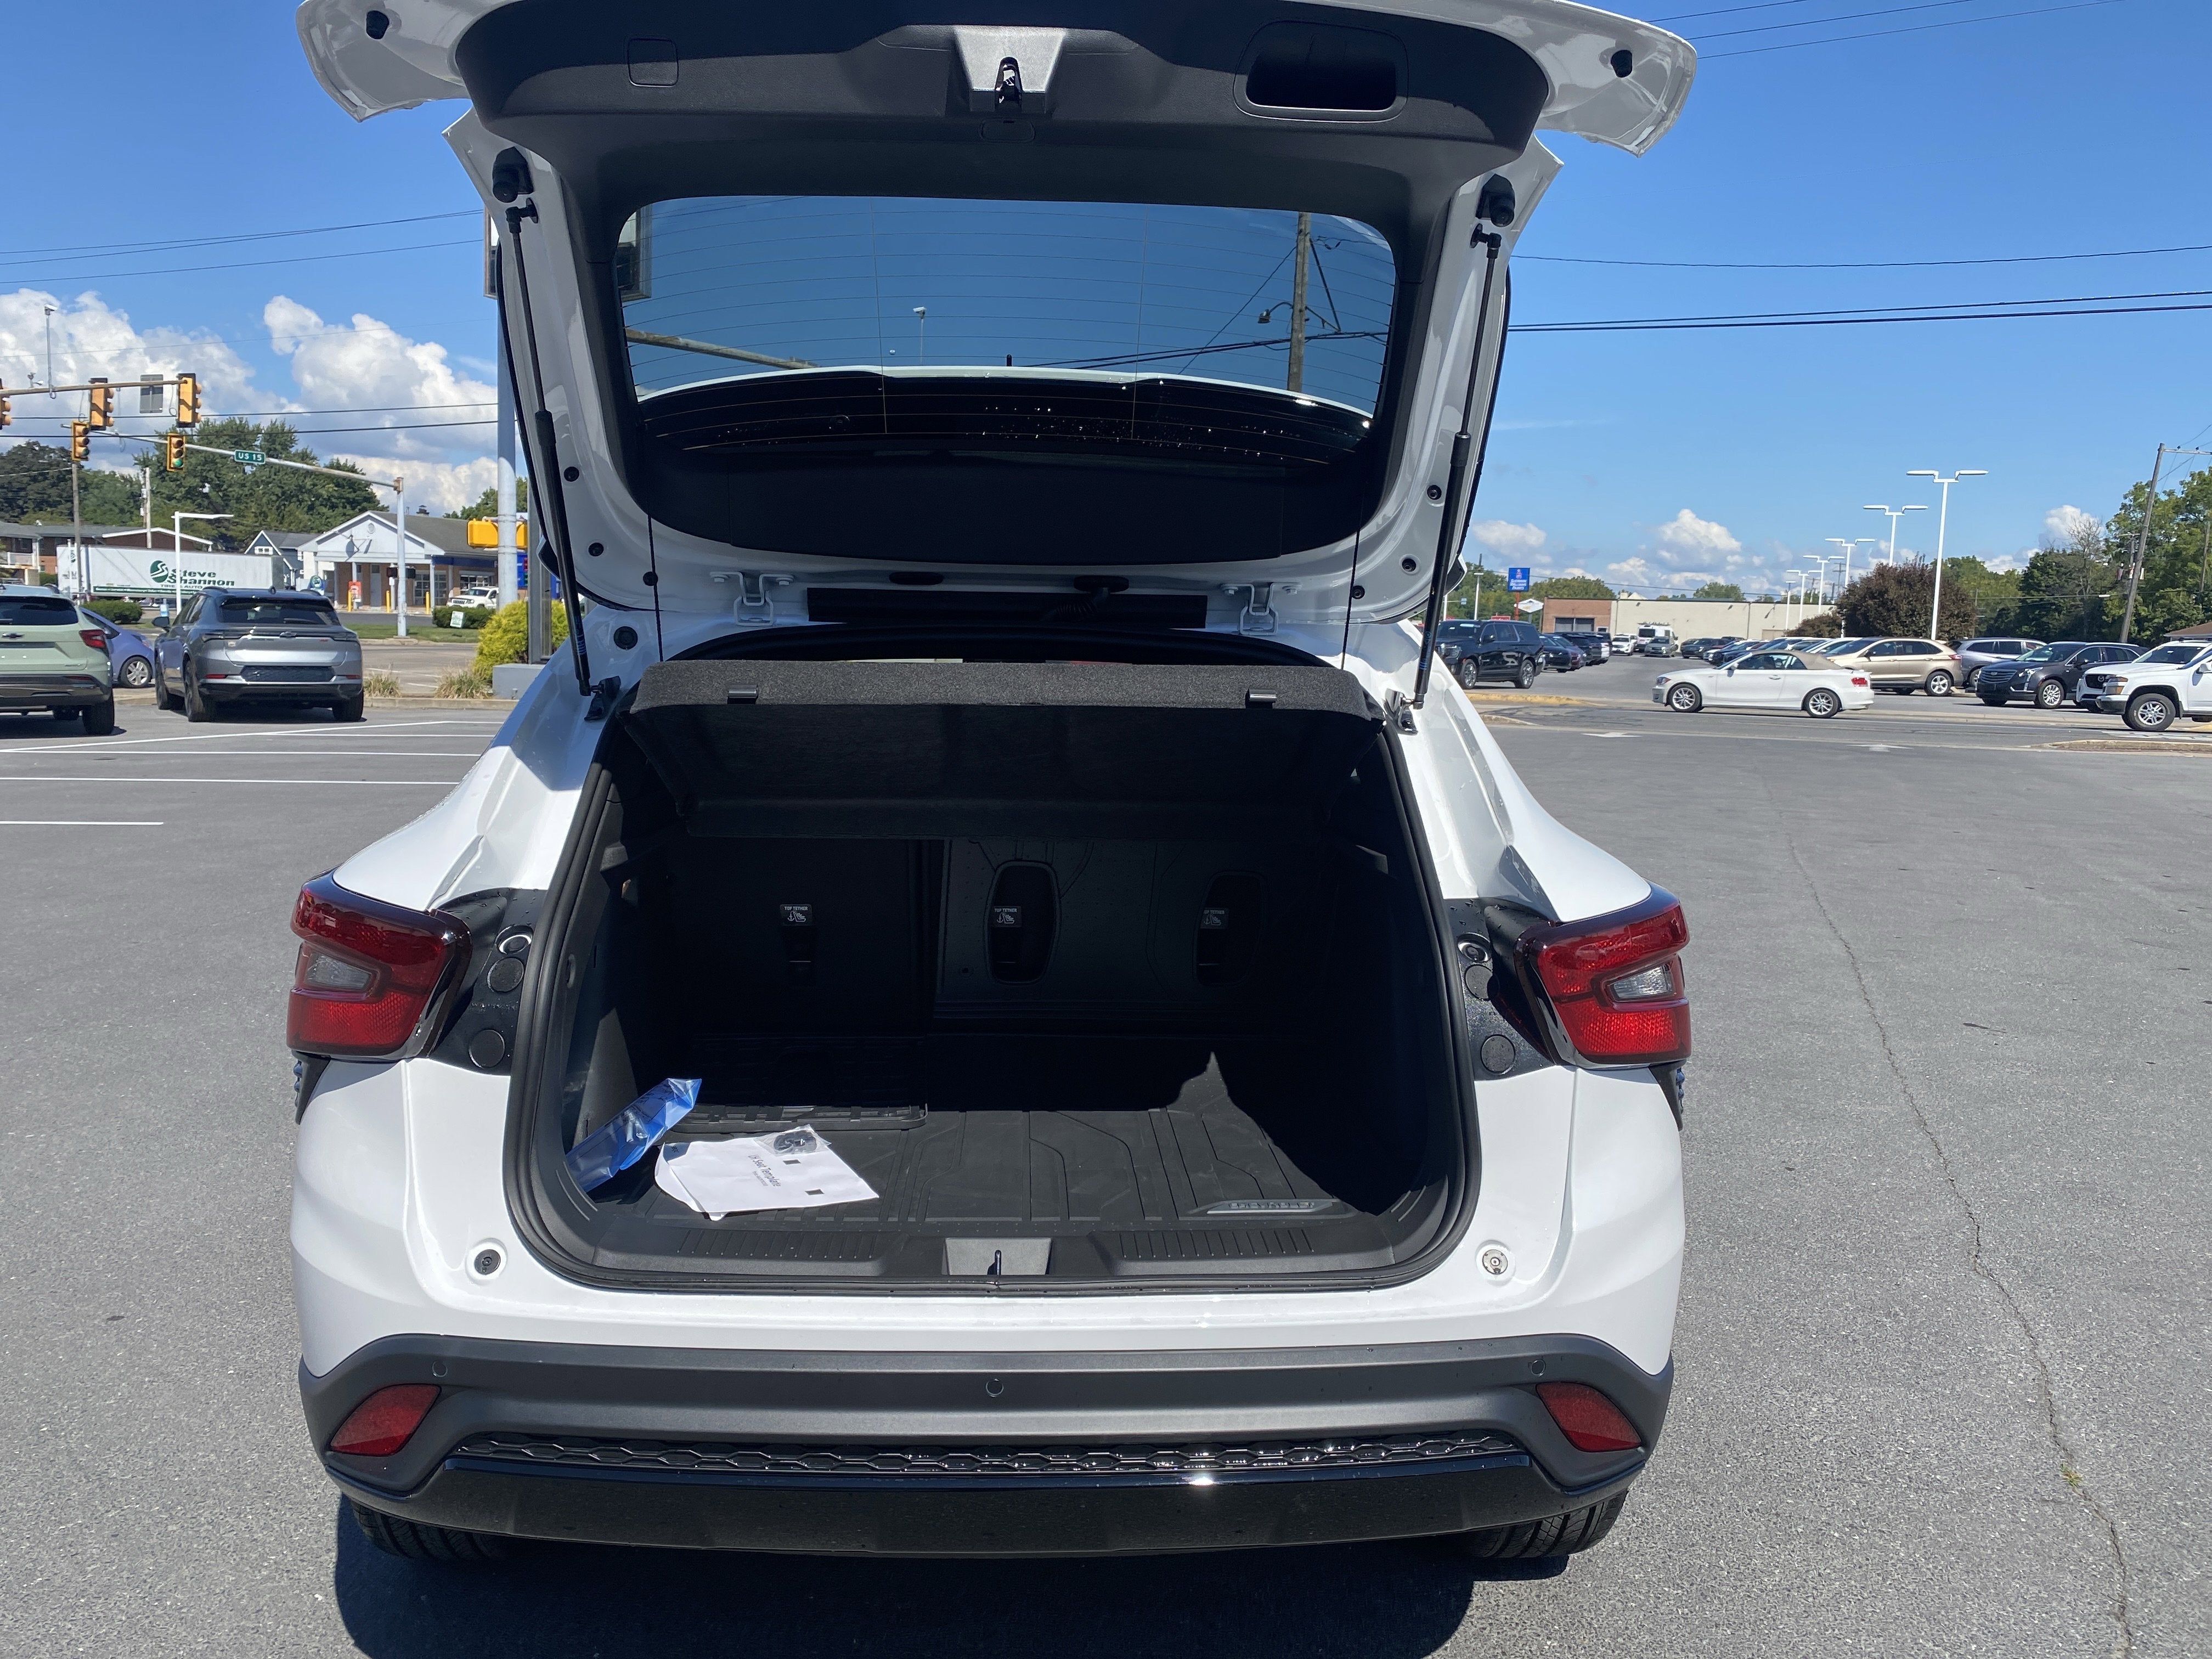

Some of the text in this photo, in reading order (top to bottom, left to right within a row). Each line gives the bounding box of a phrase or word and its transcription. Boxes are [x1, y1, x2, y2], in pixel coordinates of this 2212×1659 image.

[167, 573, 235, 586] Shannon
[171, 568, 216, 578] Steve
[752, 1159, 768, 1168] Seat
[760, 1167, 781, 1187] Template
